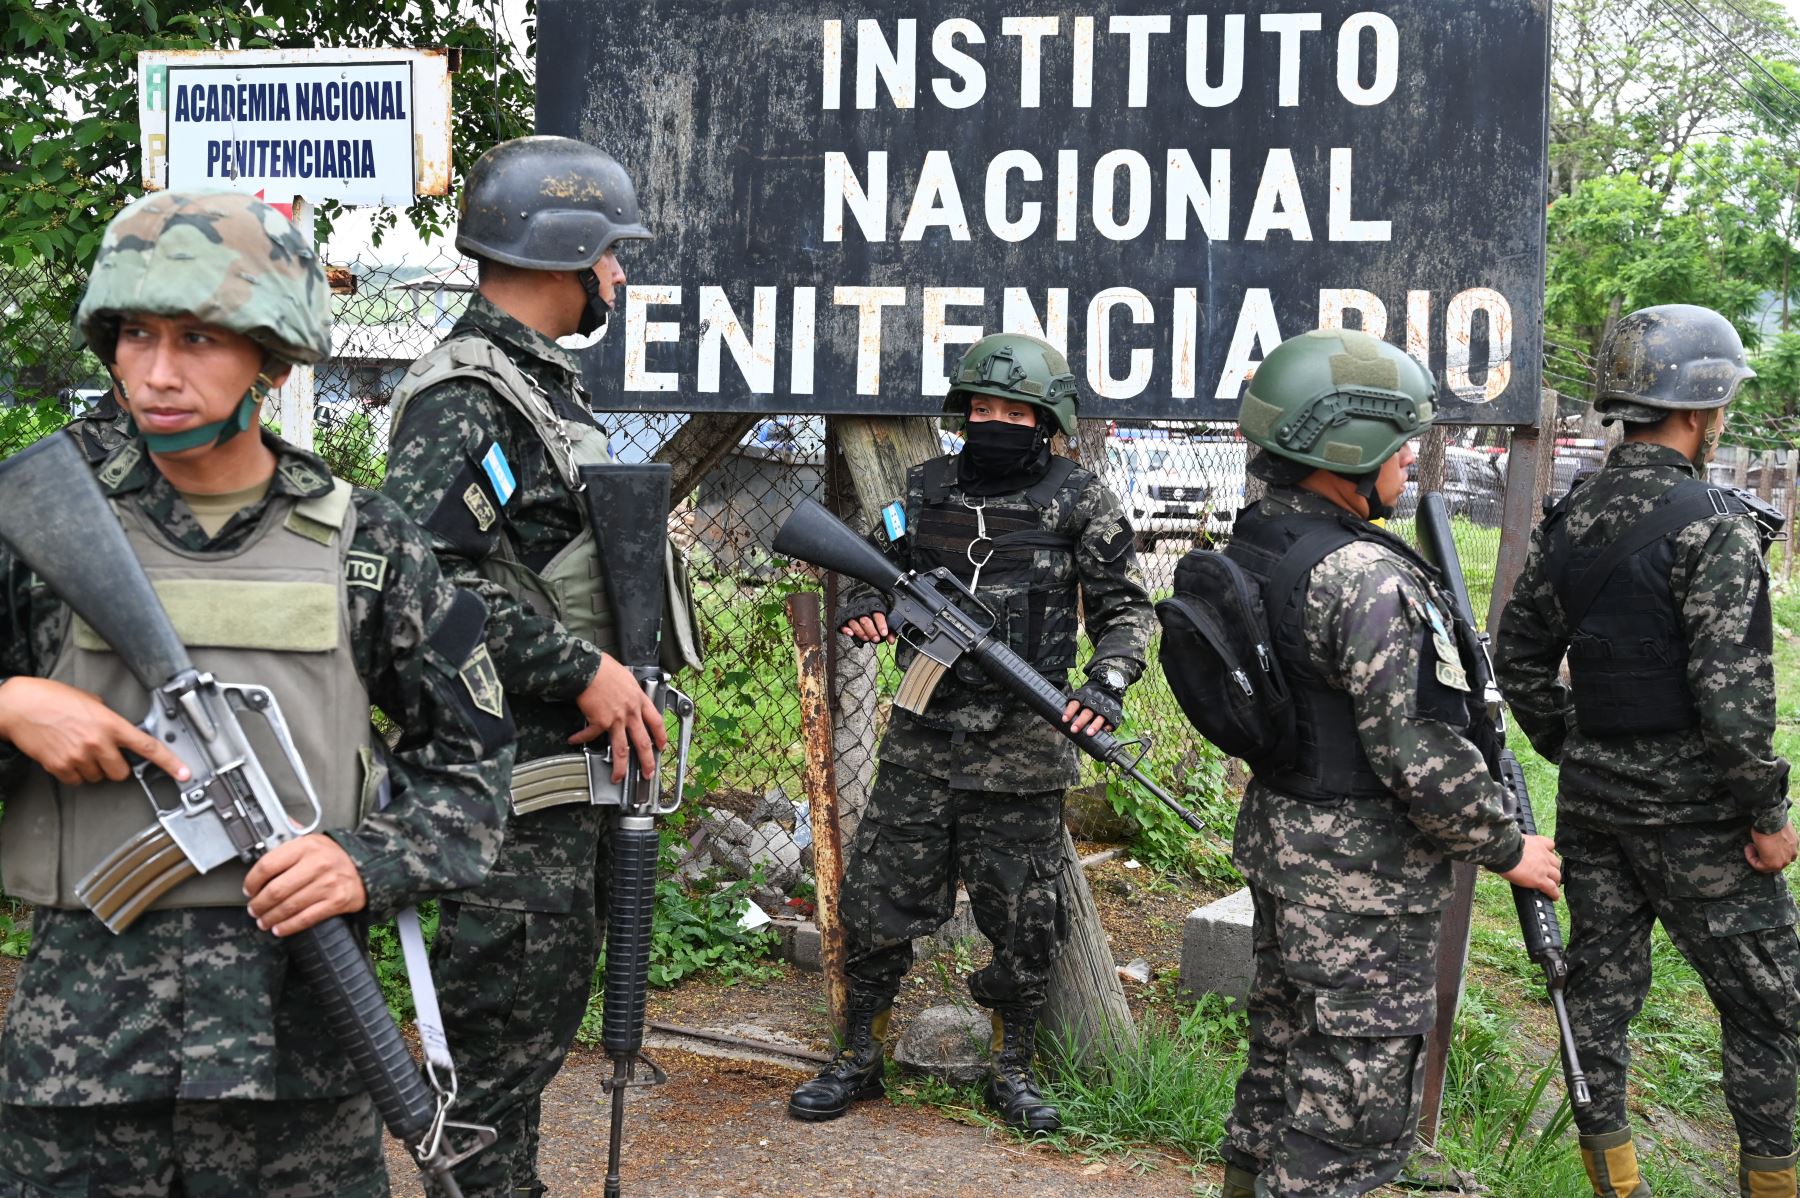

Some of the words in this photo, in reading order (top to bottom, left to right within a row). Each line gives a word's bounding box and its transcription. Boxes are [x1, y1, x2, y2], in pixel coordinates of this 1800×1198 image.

[822, 11, 1400, 110] INSTITUTO
[175, 83, 291, 122] ACADEMIA
[295, 80, 406, 121] NACIONAL
[207, 139, 376, 179] PENITENCIARIA
[822, 147, 1393, 243] NACIONAL
